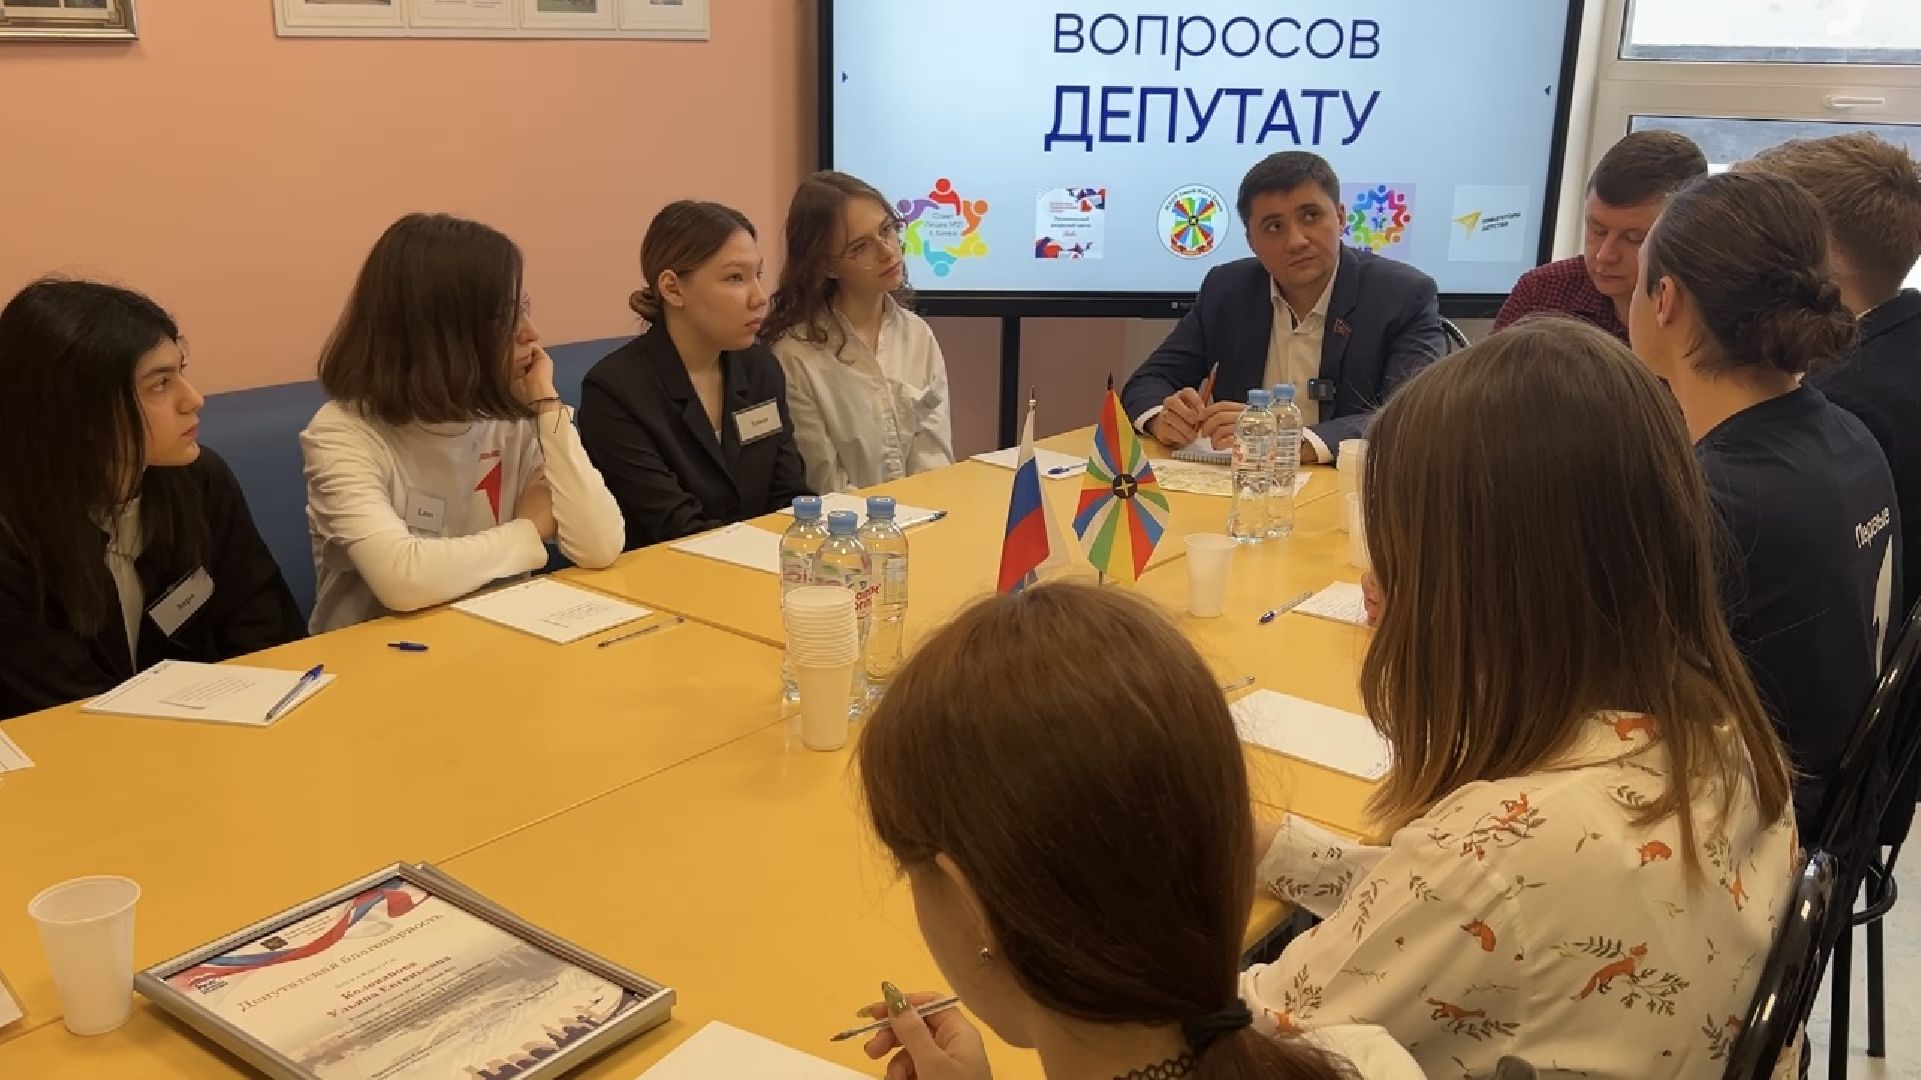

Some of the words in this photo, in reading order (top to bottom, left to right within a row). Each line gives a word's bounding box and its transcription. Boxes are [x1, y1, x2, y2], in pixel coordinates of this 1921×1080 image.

[1053, 13, 1380, 71] вопросов
[1044, 85, 1381, 152] ДЕПУТАТУ
[1855, 507, 1890, 548] Первые
[238, 962, 339, 1013] Депутатская
